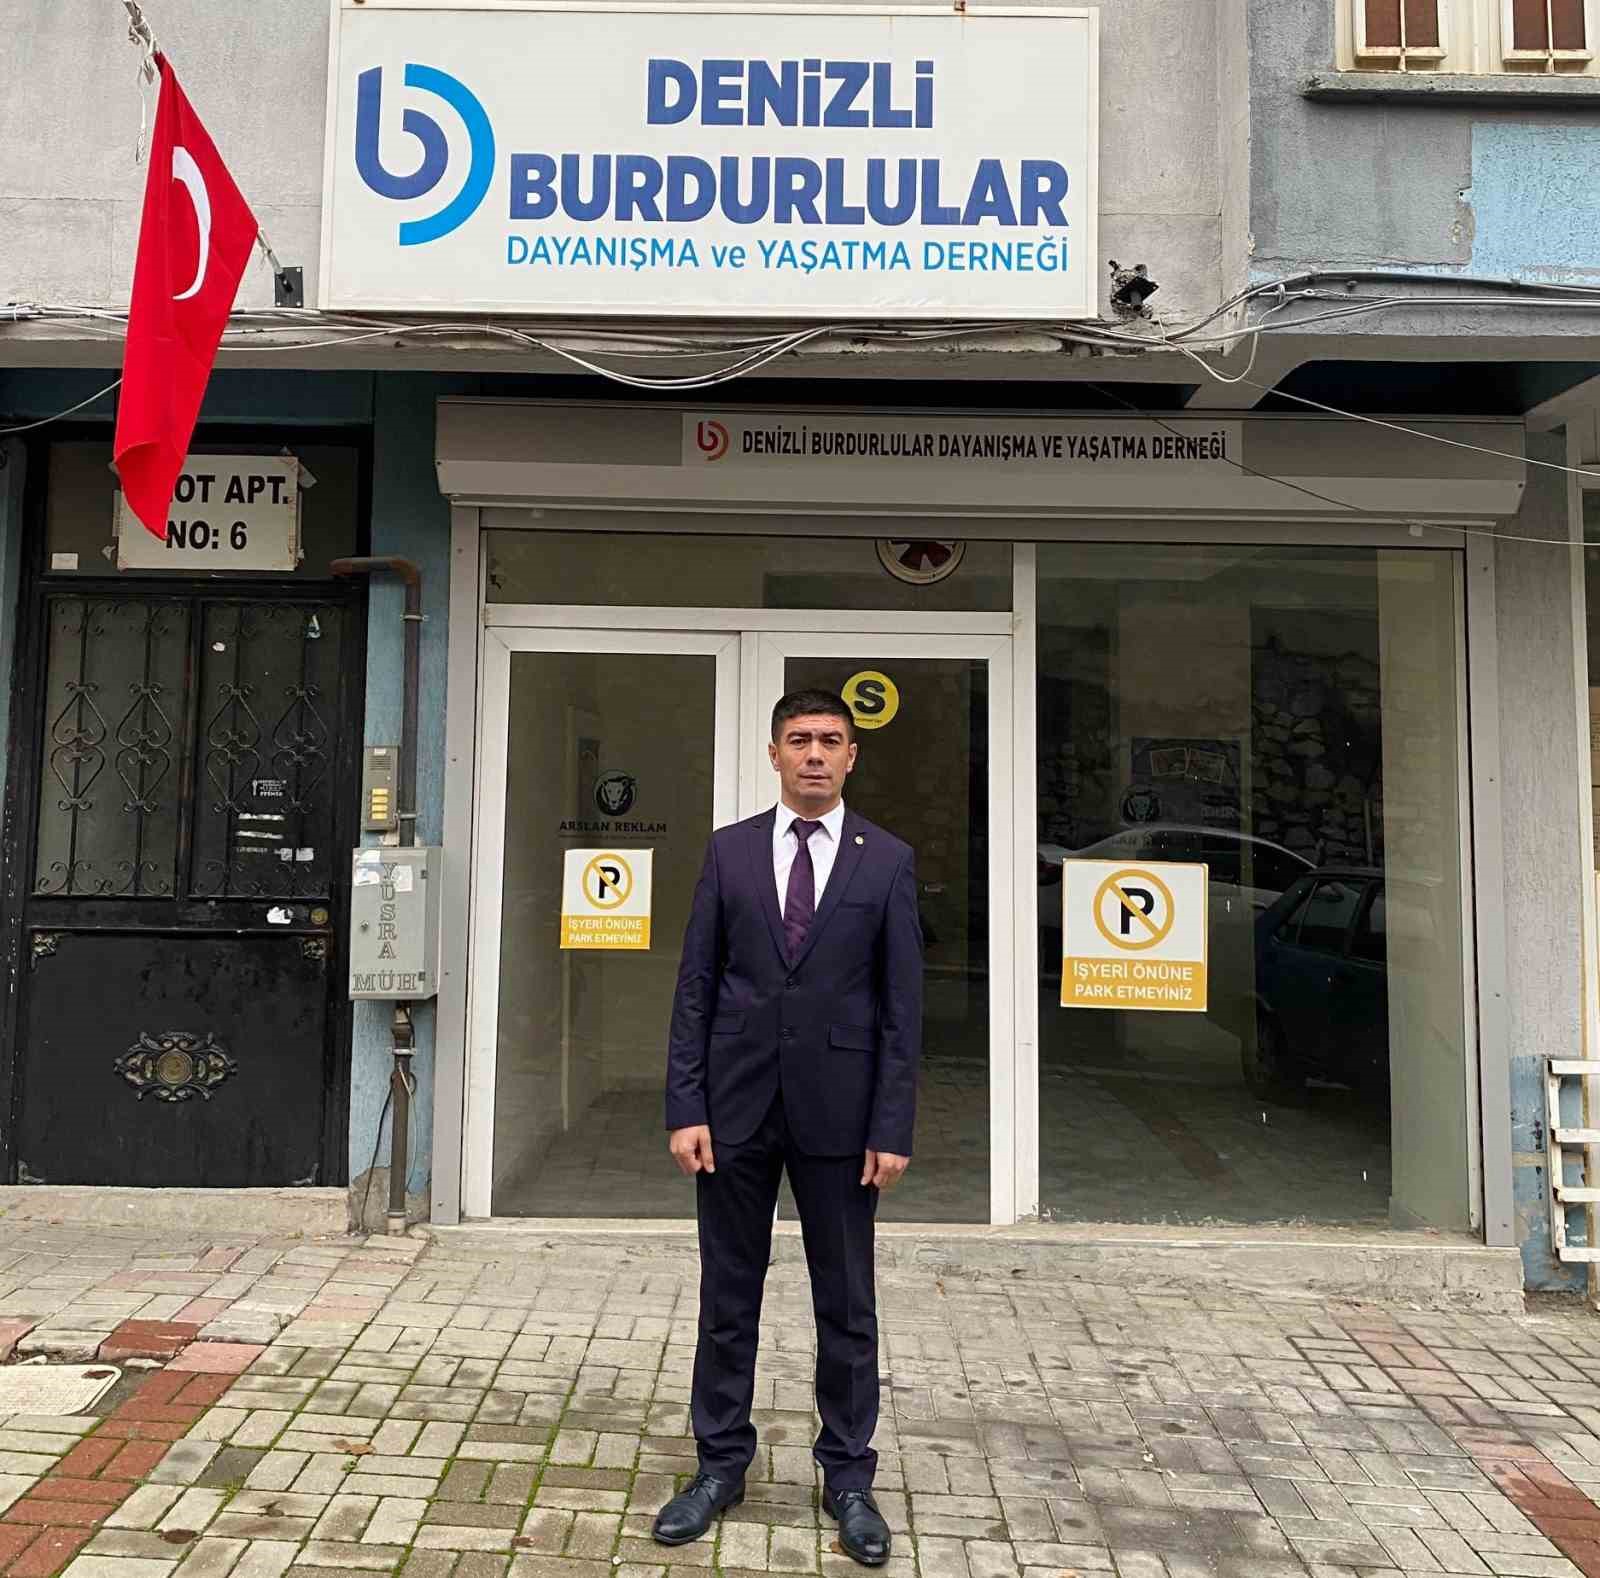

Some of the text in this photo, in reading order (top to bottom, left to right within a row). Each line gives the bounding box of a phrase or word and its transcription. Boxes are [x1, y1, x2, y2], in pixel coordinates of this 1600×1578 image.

[510, 153, 1070, 227] BURDURLULAR
[507, 235, 1069, 275] DAYANIŞMA ve YAŞATMA DERNEĞİ
[742, 424, 1226, 462] DENİZLİ BURDURLULAR DAYANIŞMA VE YAŞATMA DERNEĞİ
[170, 474, 289, 505] OT APT.
[166, 520, 248, 551] NO: 6
[854, 679, 886, 714] S
[559, 821, 667, 834] ARSLAN REKLAM
[569, 933, 593, 945] PARK
[606, 917, 642, 930] ÖNÜNE
[1073, 961, 1193, 981] İŞYERİ ÖNÜNE
[1075, 983, 1193, 1001] PARK ETMEYİNİZ
